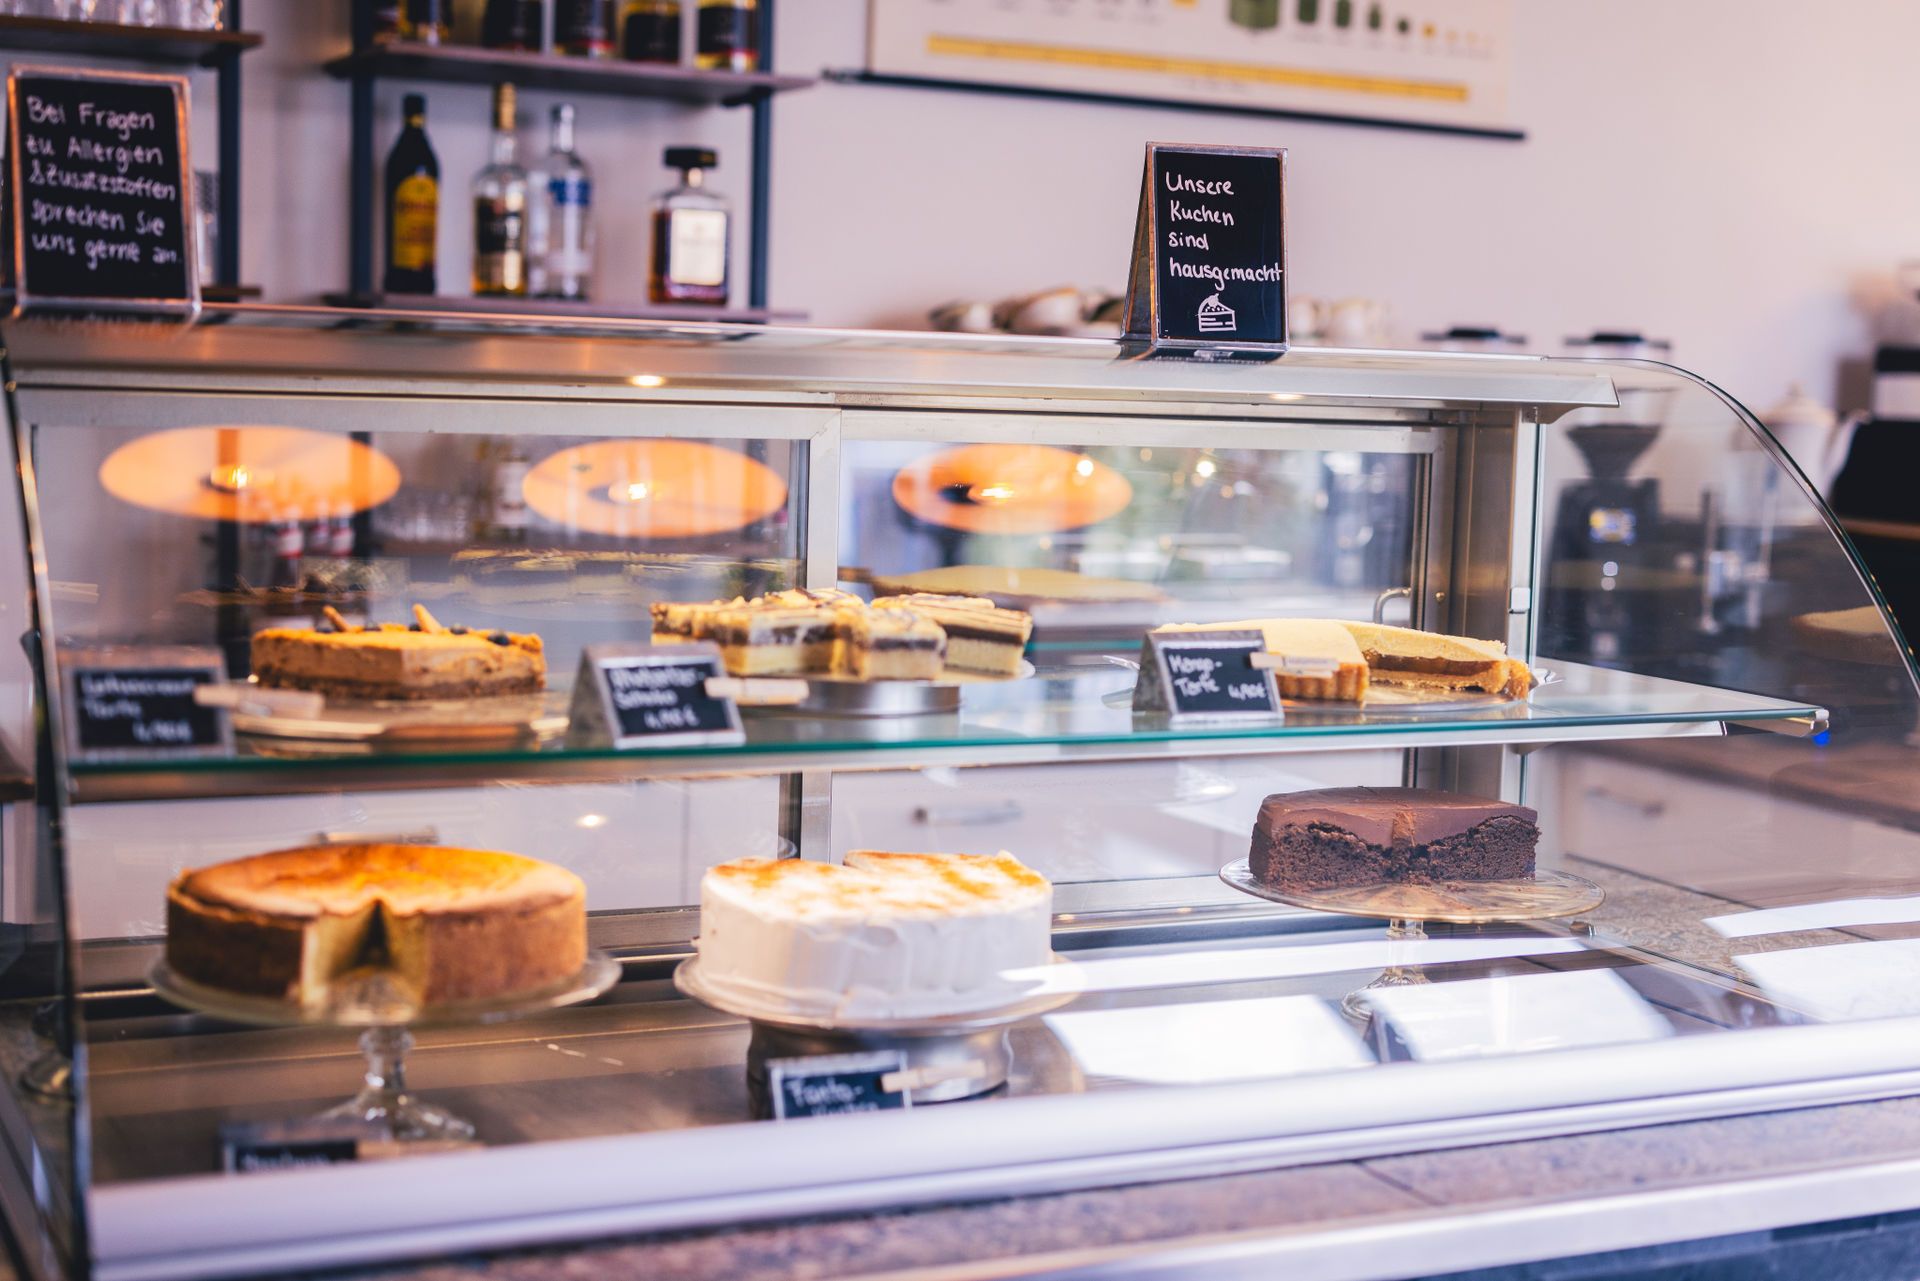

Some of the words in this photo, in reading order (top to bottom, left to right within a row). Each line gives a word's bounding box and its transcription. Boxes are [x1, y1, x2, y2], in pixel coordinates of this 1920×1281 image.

[27, 95, 66, 124] Bei
[78, 102, 155, 141] Fragen
[67, 136, 164, 174] Allergien
[1165, 171, 1235, 196] Unsere
[31, 198, 126, 233] sprechen
[135, 210, 166, 237] Sie
[1170, 199, 1235, 226] Kuchen
[32, 232, 76, 256] uns
[84, 240, 141, 270] gerne
[1168, 232, 1210, 250] sind
[1169, 257, 1283, 292] hausgemacht
